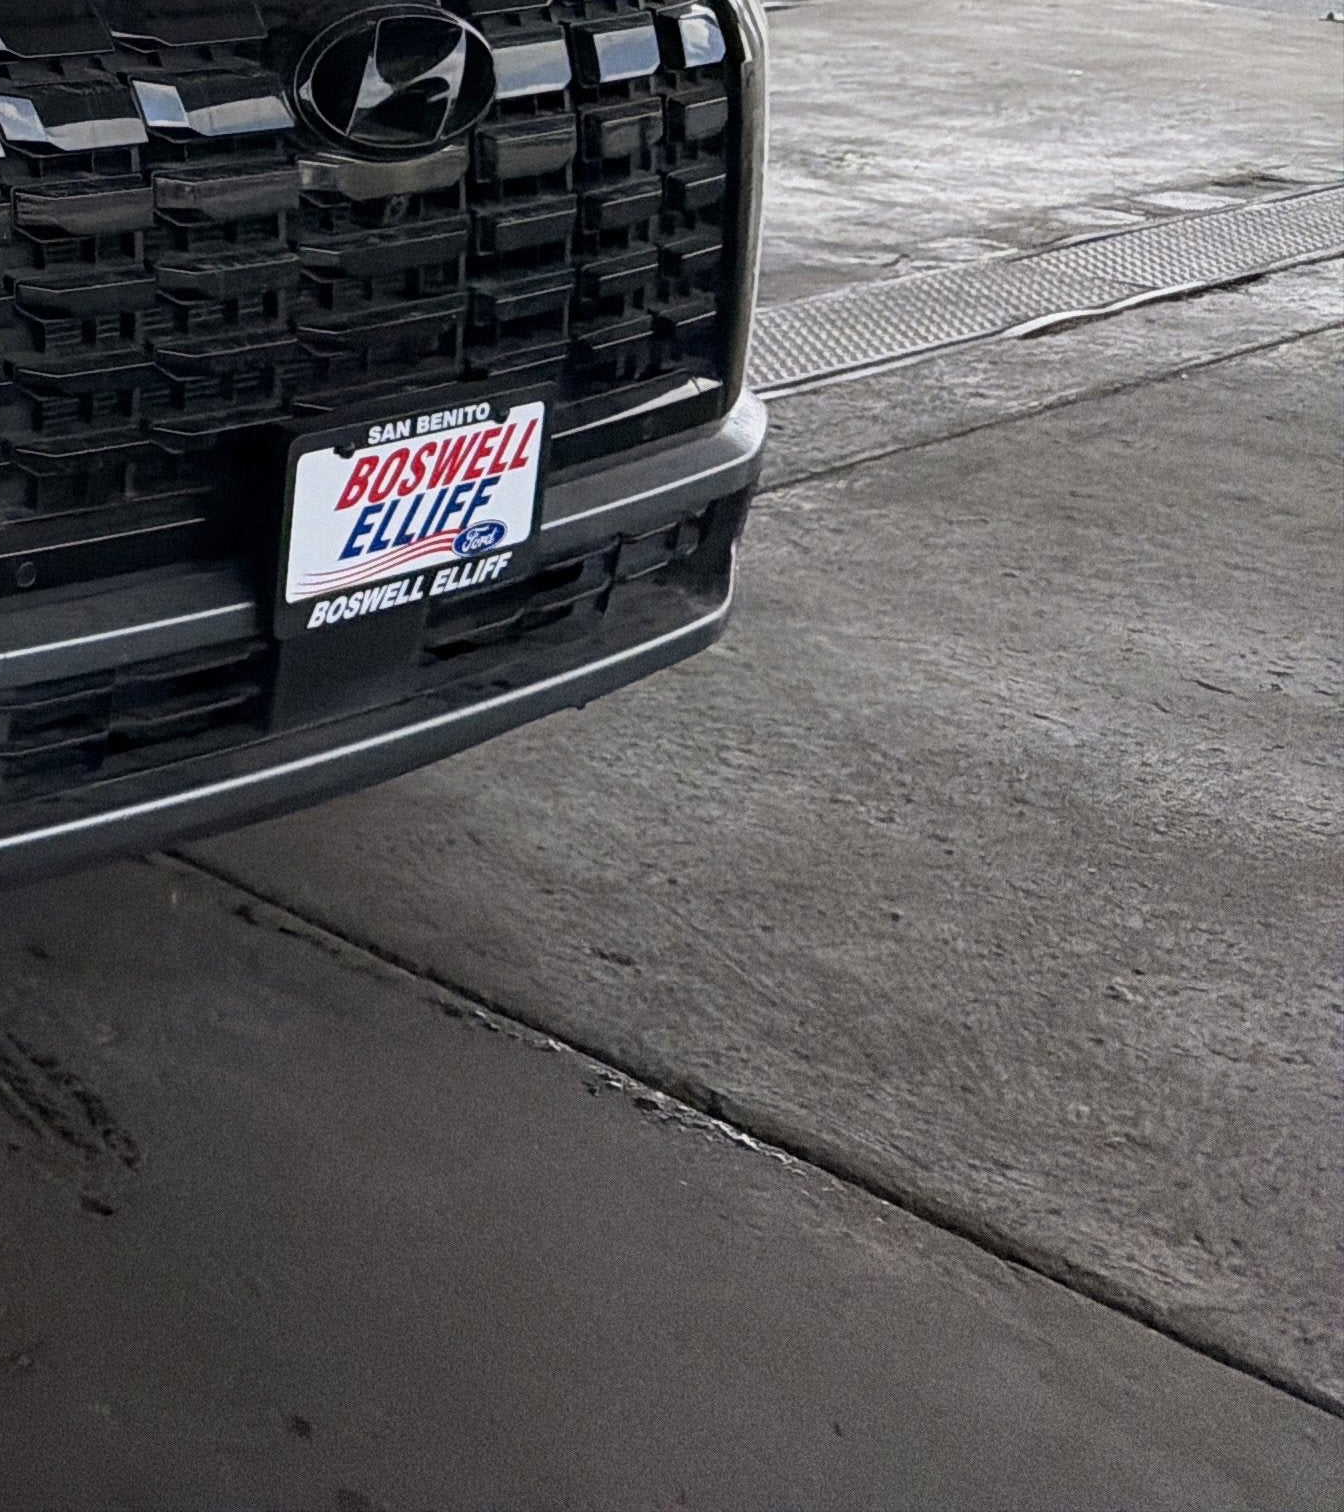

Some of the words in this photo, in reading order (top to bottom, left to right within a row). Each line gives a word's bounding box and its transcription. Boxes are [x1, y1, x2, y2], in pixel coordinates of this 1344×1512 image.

[367, 419, 411, 445] SAN
[416, 402, 490, 431] BENITO
[333, 418, 538, 511] BOSWELL
[337, 476, 501, 561] ELLIFF
[459, 525, 501, 553] Ford
[307, 572, 424, 629] BOSWELL
[429, 552, 512, 595] ELLIFF
